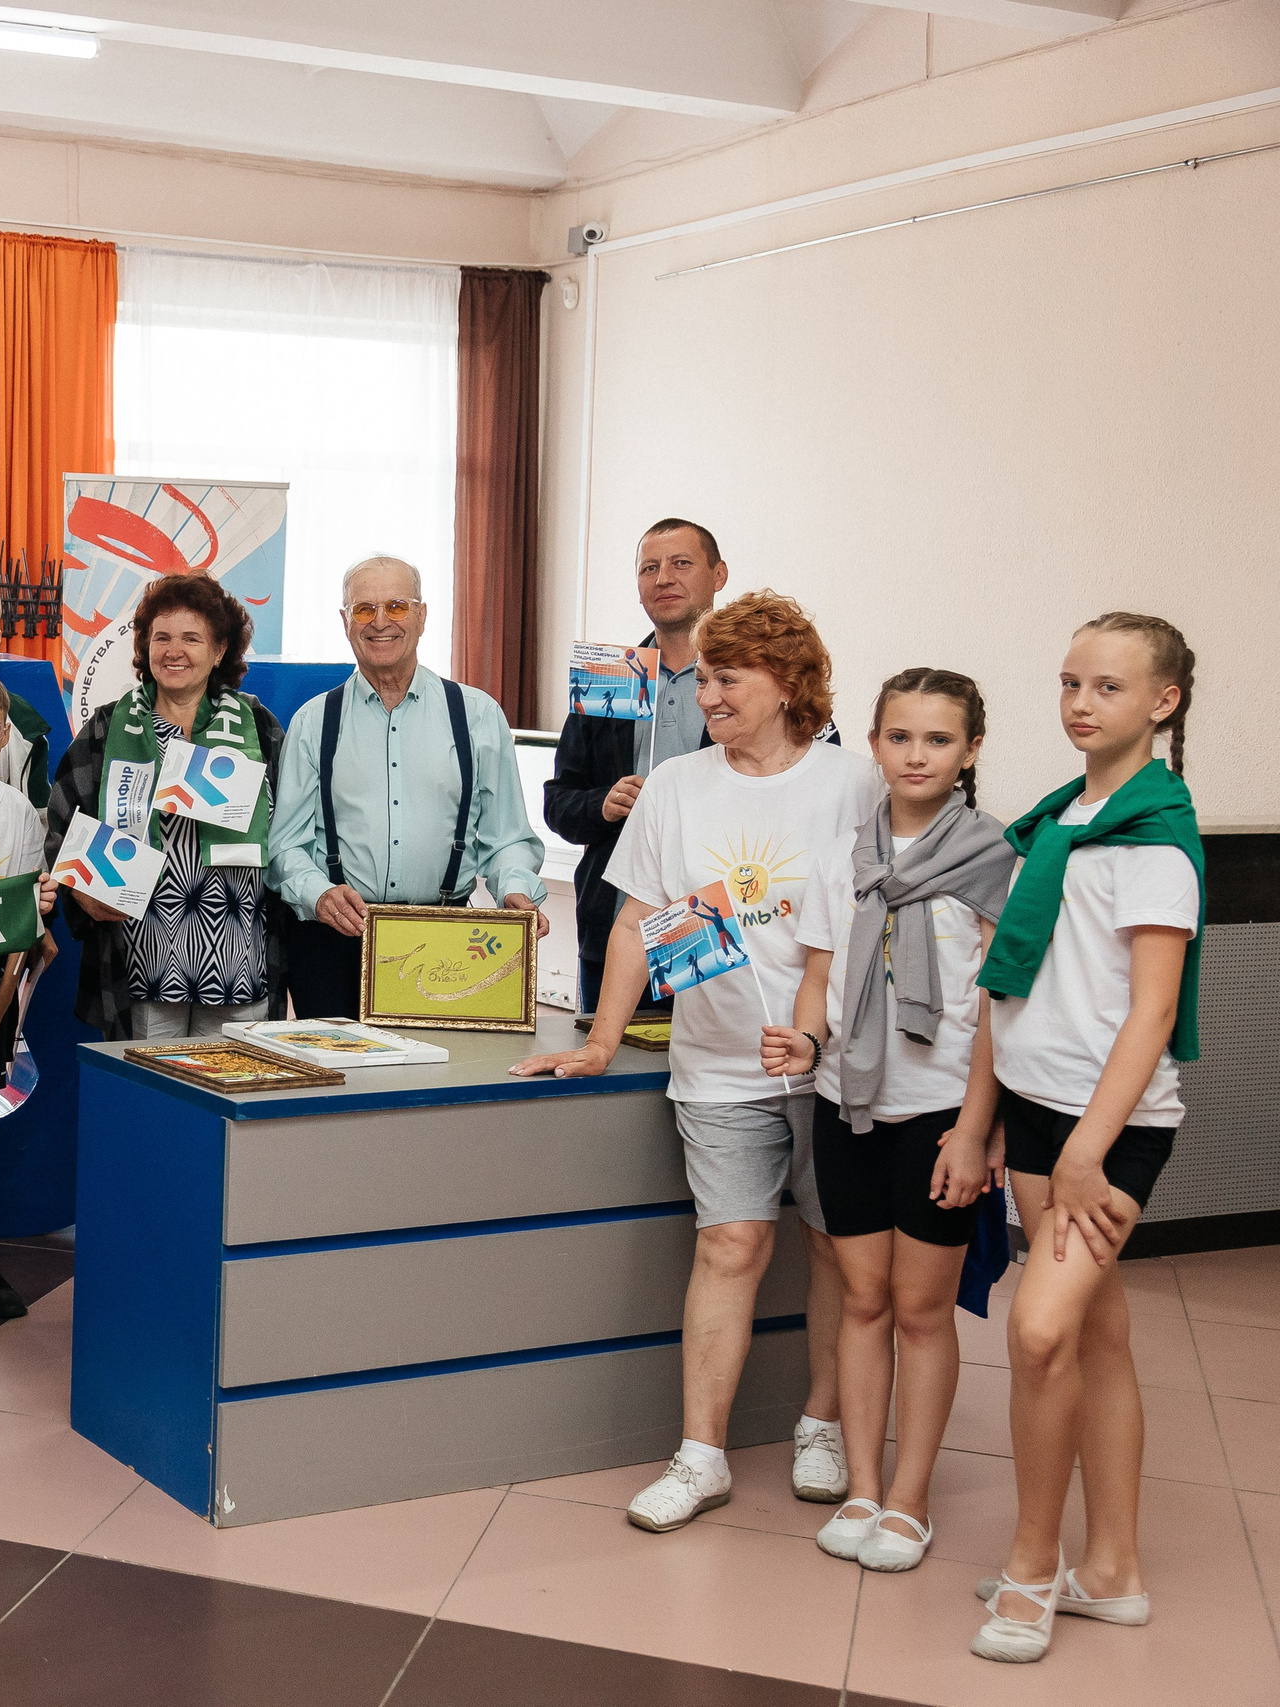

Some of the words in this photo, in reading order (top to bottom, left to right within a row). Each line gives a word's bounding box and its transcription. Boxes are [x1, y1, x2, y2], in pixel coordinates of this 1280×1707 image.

[574, 644, 603, 652] ДВИЖЕНИЕ
[573, 654, 601, 662] ТРАДИЦИЯ
[590, 651, 620, 659] СЕМЕЙНАЯ
[117, 766, 135, 829] ПСПФНР
[644, 922, 660, 933] НАША
